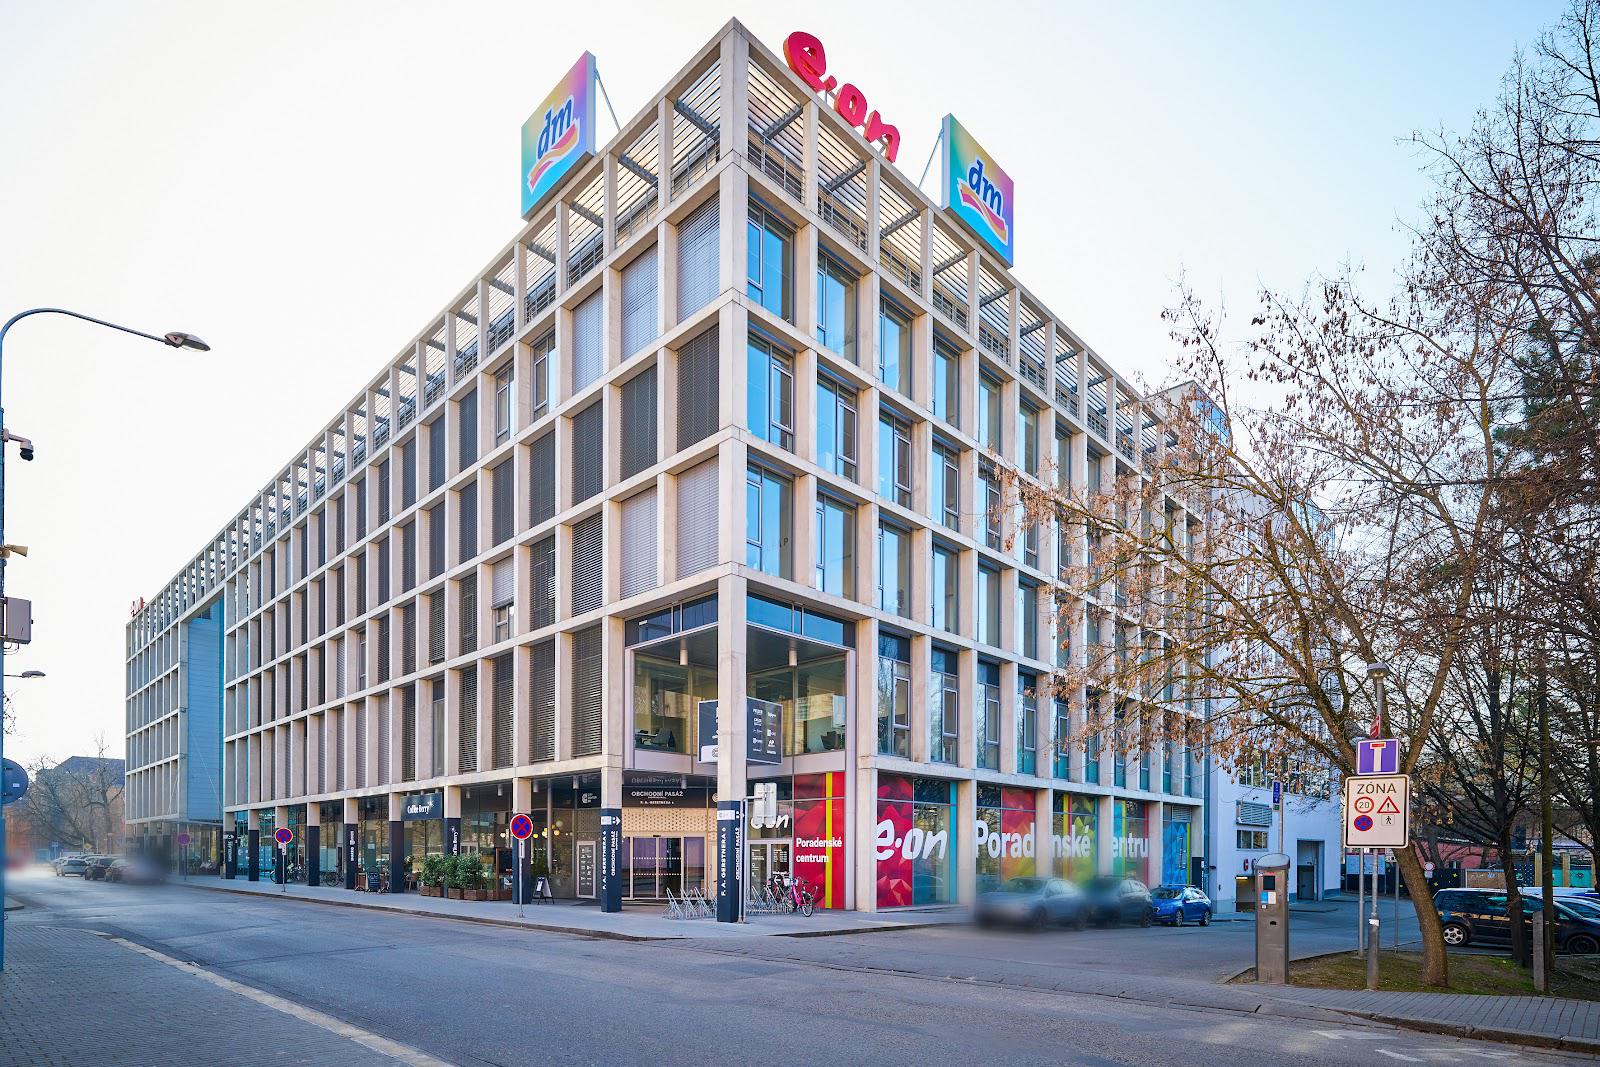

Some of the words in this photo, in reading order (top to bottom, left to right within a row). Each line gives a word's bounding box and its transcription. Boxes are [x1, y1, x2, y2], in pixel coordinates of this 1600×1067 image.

[538, 98, 572, 160] dm
[968, 159, 1002, 216] dm
[1357, 781, 1397, 794] ZÓNA
[407, 804, 419, 815] Coffee
[418, 804, 430, 815] Berry
[1359, 801, 1370, 809] 20
[796, 836, 842, 848] Poradenské
[796, 853, 830, 863] centrum
